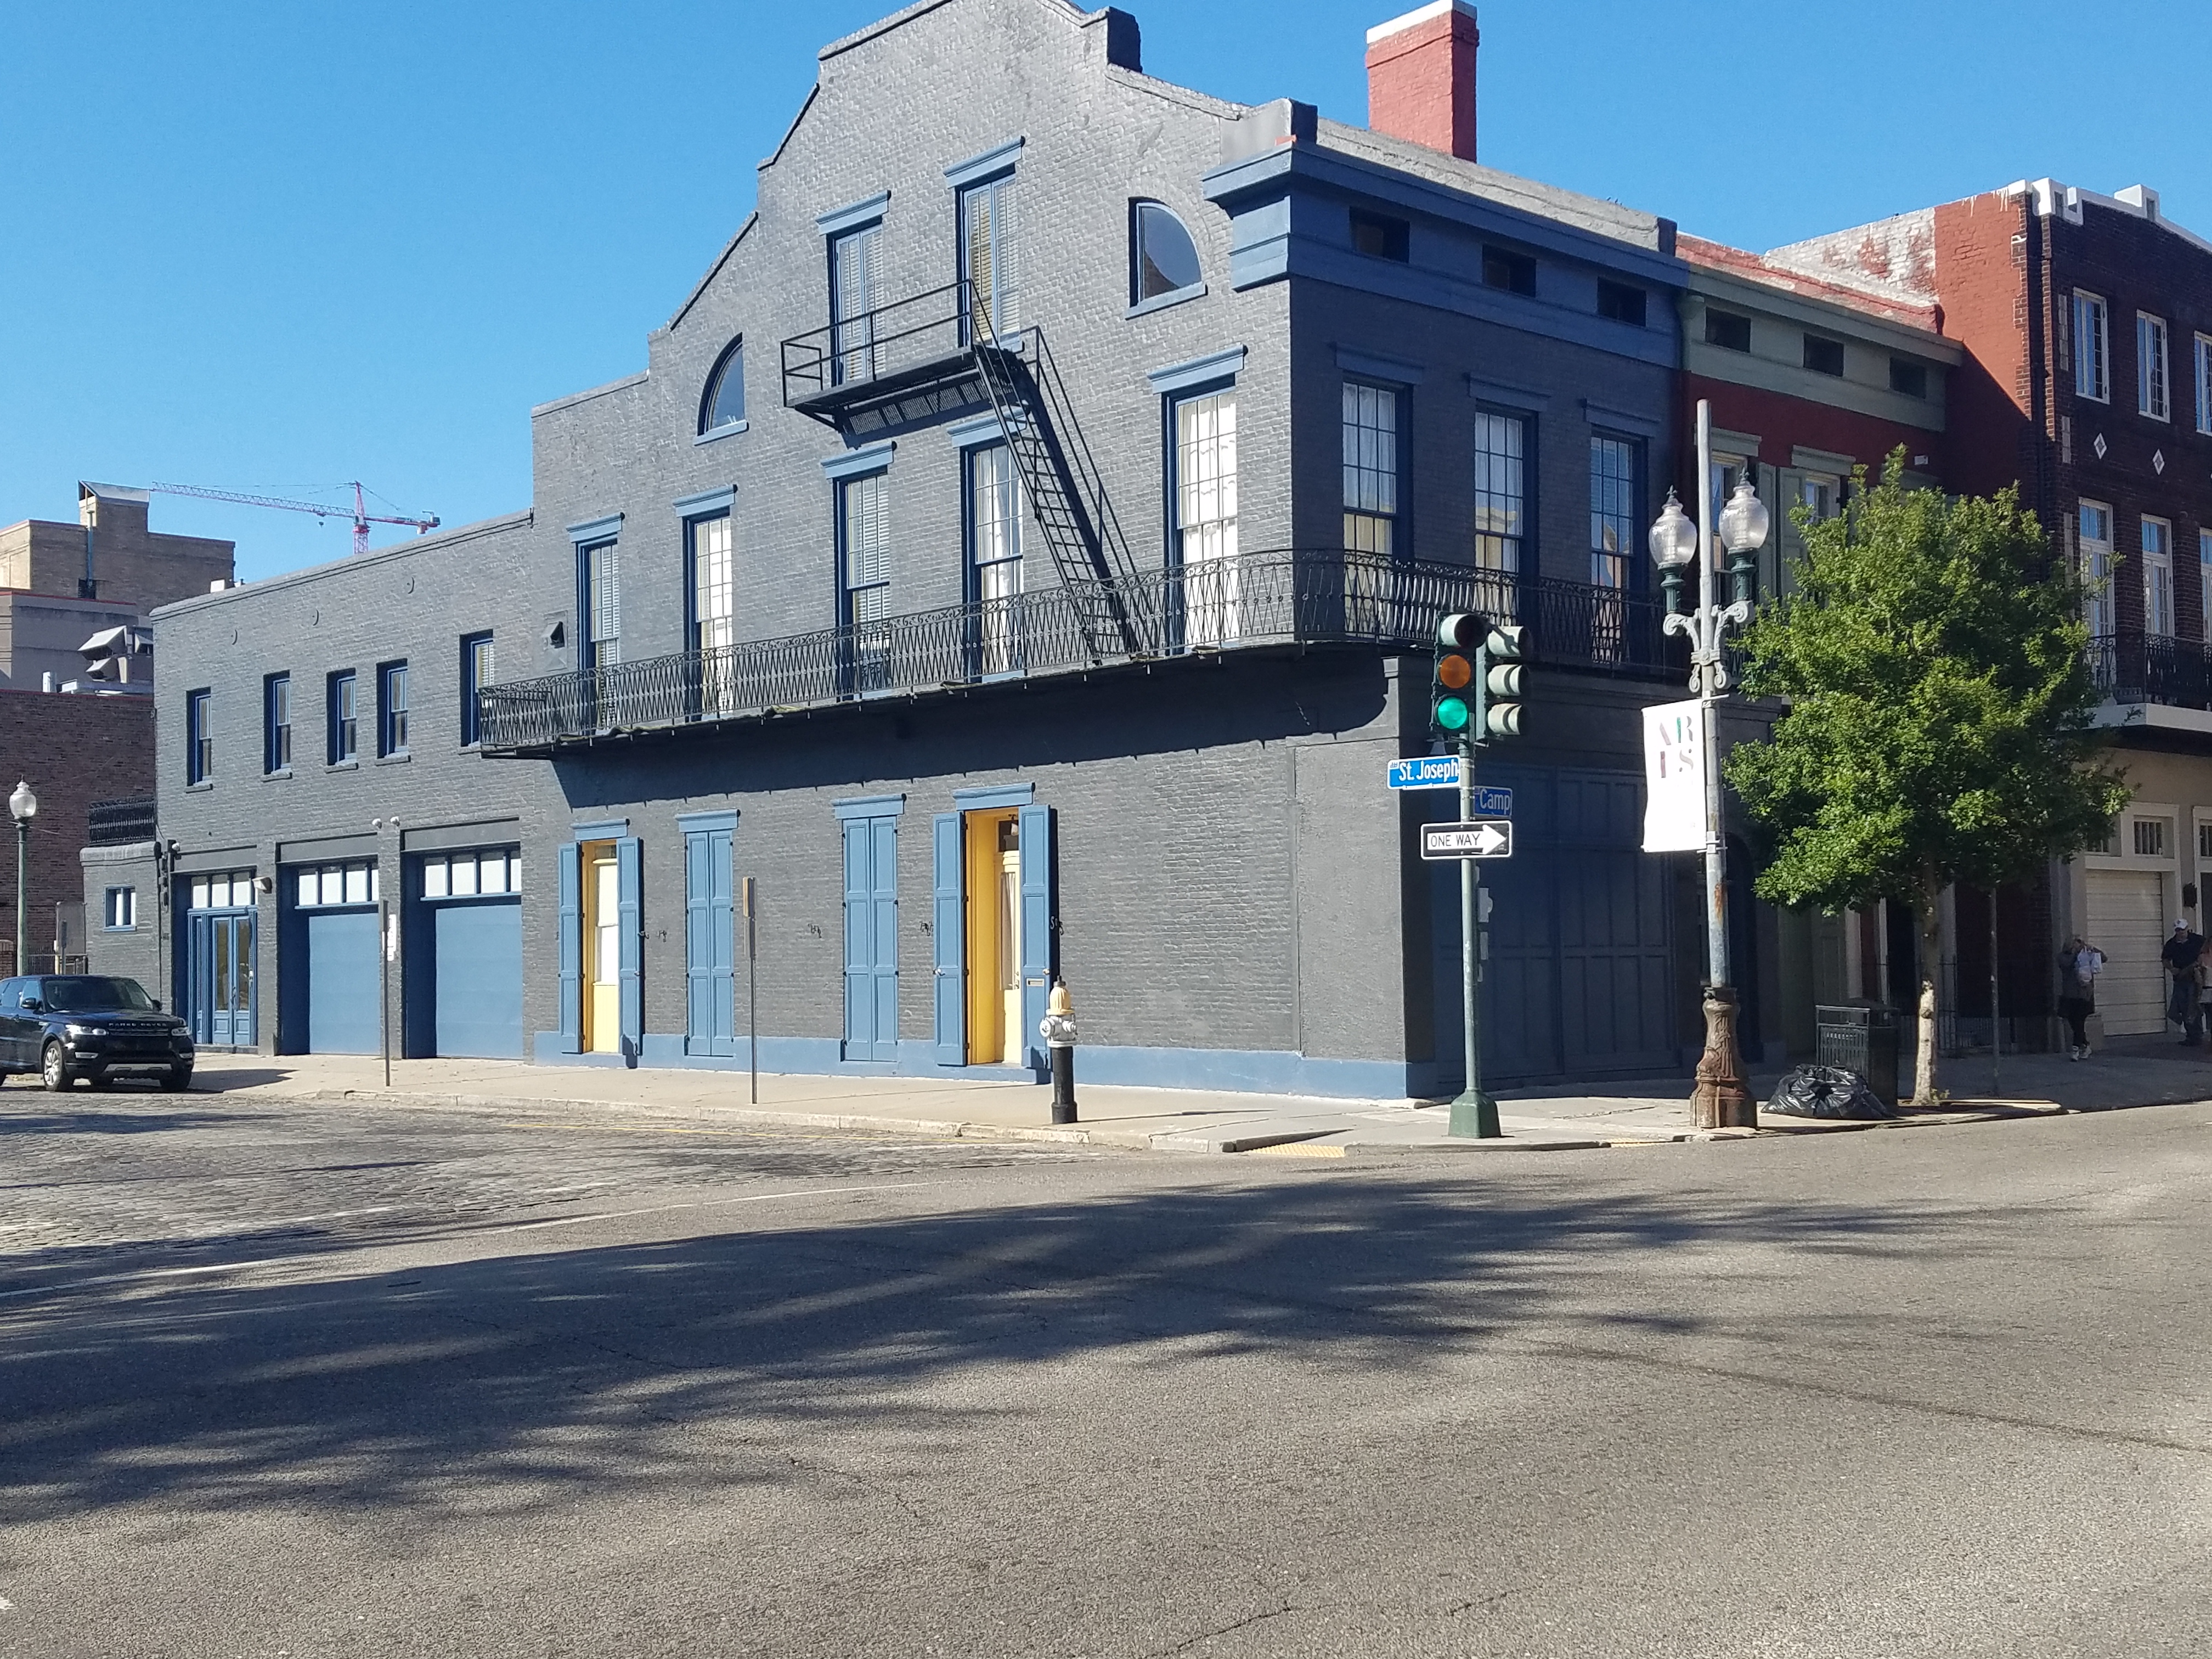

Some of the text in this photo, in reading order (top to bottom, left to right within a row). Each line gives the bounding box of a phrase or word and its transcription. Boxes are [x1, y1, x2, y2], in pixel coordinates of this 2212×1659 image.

[1398, 759, 1458, 782] St. Joseph
[1480, 788, 1510, 814] Camp
[1431, 834, 1480, 848] ONE WAY
